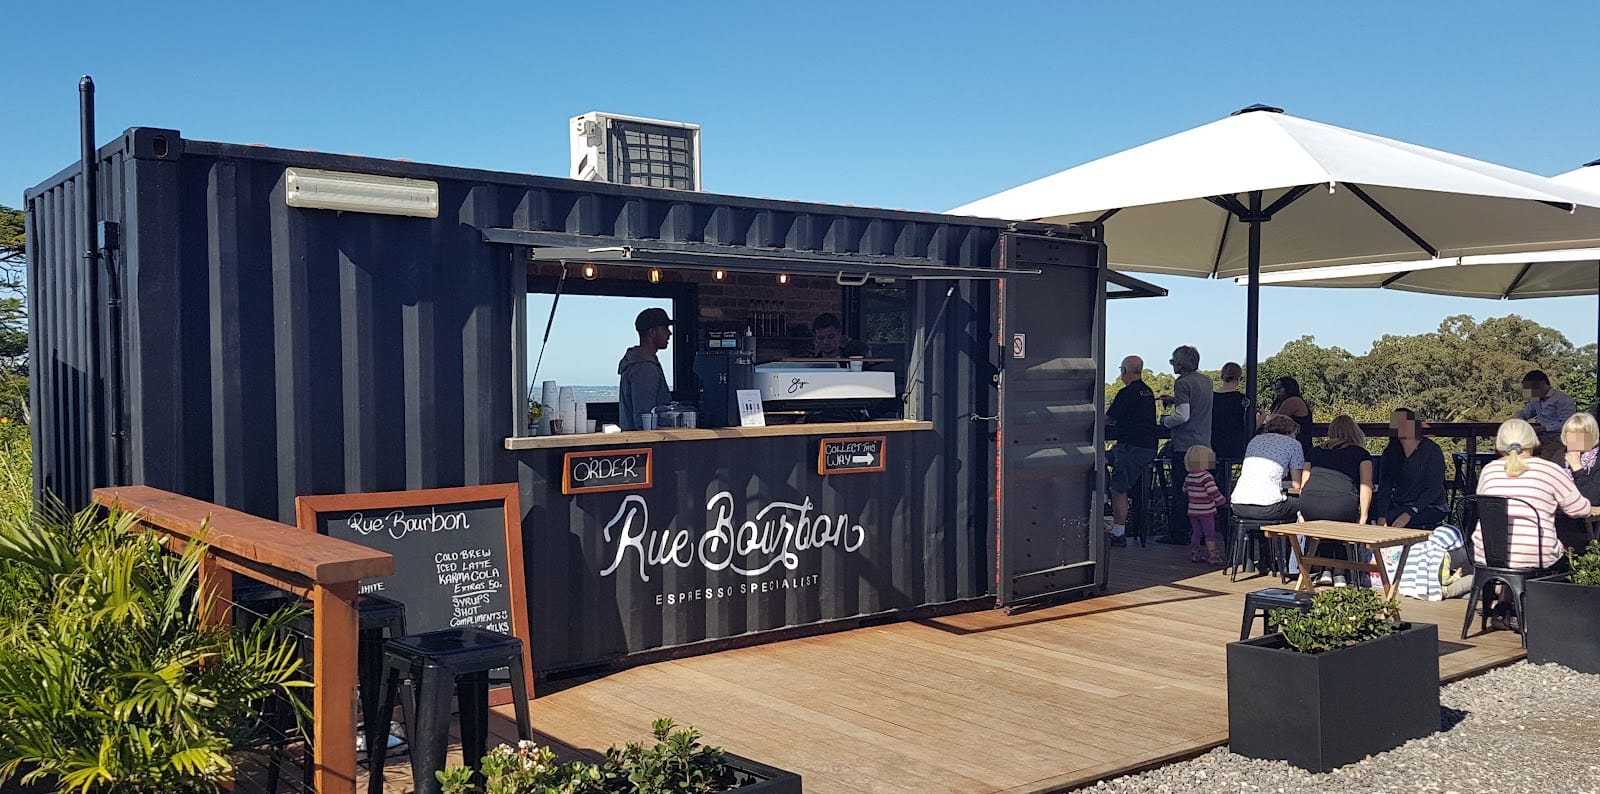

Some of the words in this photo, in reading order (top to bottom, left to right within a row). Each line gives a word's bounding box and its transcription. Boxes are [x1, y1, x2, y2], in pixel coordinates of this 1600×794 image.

[825, 443, 861, 454] COLLECT
[827, 454, 851, 466] WAY
[573, 456, 638, 481] ORDER
[347, 512, 385, 535] Rue
[385, 506, 470, 539] Bourbon
[600, 494, 694, 582] Rue
[698, 491, 865, 576] Bourbon
[434, 552, 459, 564] COLD
[460, 549, 491, 560] BREW
[436, 562, 457, 573] ICED
[462, 559, 492, 571] LATTE
[655, 587, 733, 605] ESPRESSO
[740, 574, 818, 594] SPECIALIST
[452, 593, 490, 608] SYRUPS
[453, 605, 482, 617] SHOT
